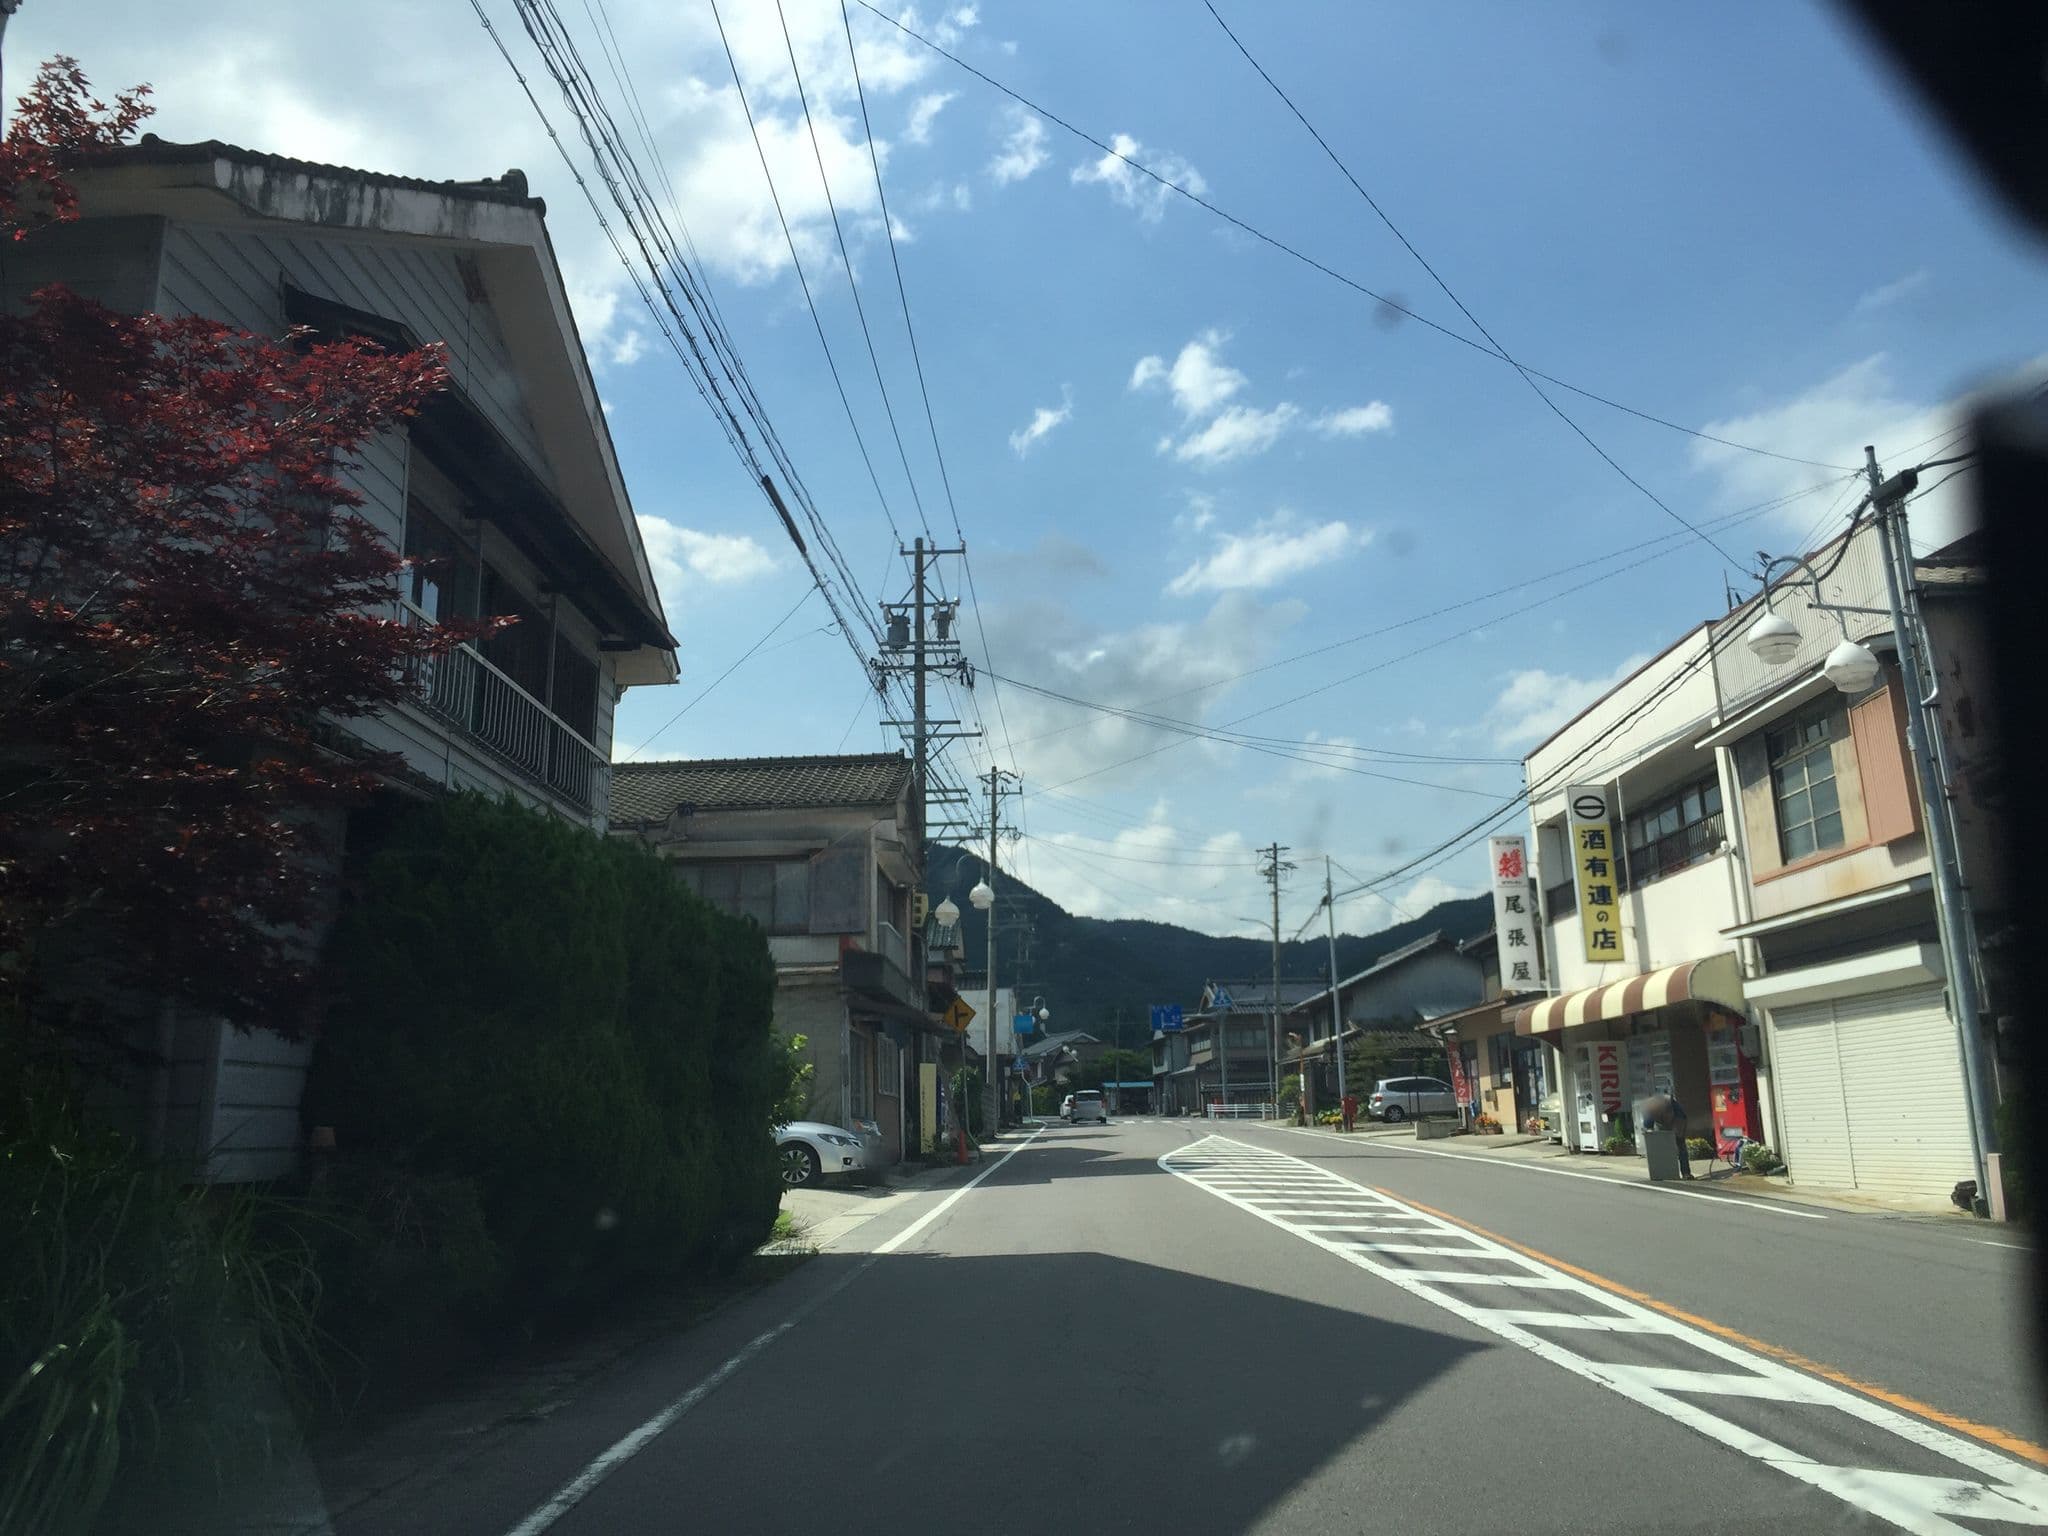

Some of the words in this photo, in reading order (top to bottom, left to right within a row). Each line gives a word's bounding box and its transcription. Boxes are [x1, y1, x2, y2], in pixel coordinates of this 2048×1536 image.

[1504, 894, 1532, 981] 尾張屋
[1580, 829, 1617, 950] 酒有連の店
